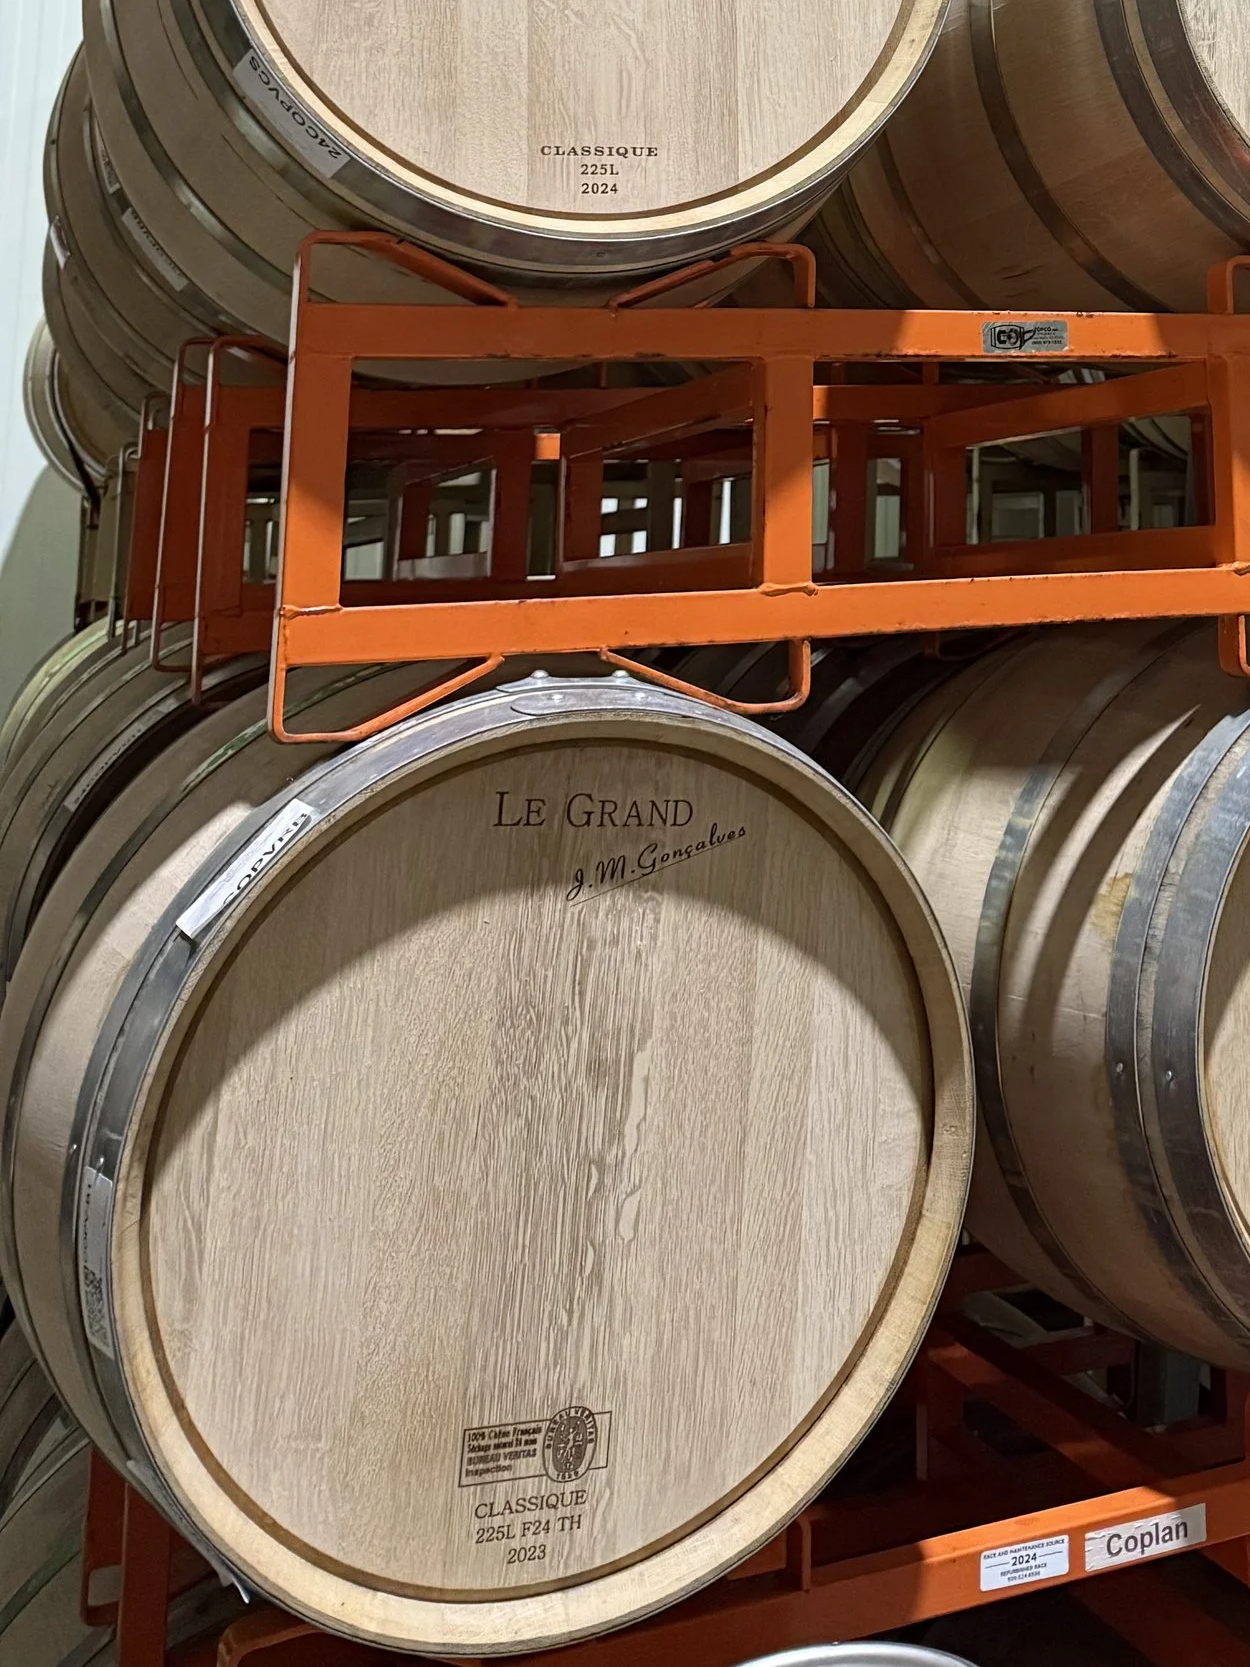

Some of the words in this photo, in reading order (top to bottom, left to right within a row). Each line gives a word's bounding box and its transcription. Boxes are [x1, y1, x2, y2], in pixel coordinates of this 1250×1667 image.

[540, 145, 658, 159] CLASSIQUE
[580, 163, 619, 175] 225L
[581, 182, 618, 195] 2024
[492, 790, 547, 827] LE
[566, 793, 693, 828] GRAND
[474, 1489, 588, 1519] CLASSIQUE
[475, 1525, 516, 1545] 225L
[522, 1519, 551, 1538] F24
[557, 1514, 582, 1532] TH
[1106, 1520, 1188, 1559] Coplan
[507, 1544, 547, 1565] 2023
[1011, 1552, 1037, 1567] 2024
